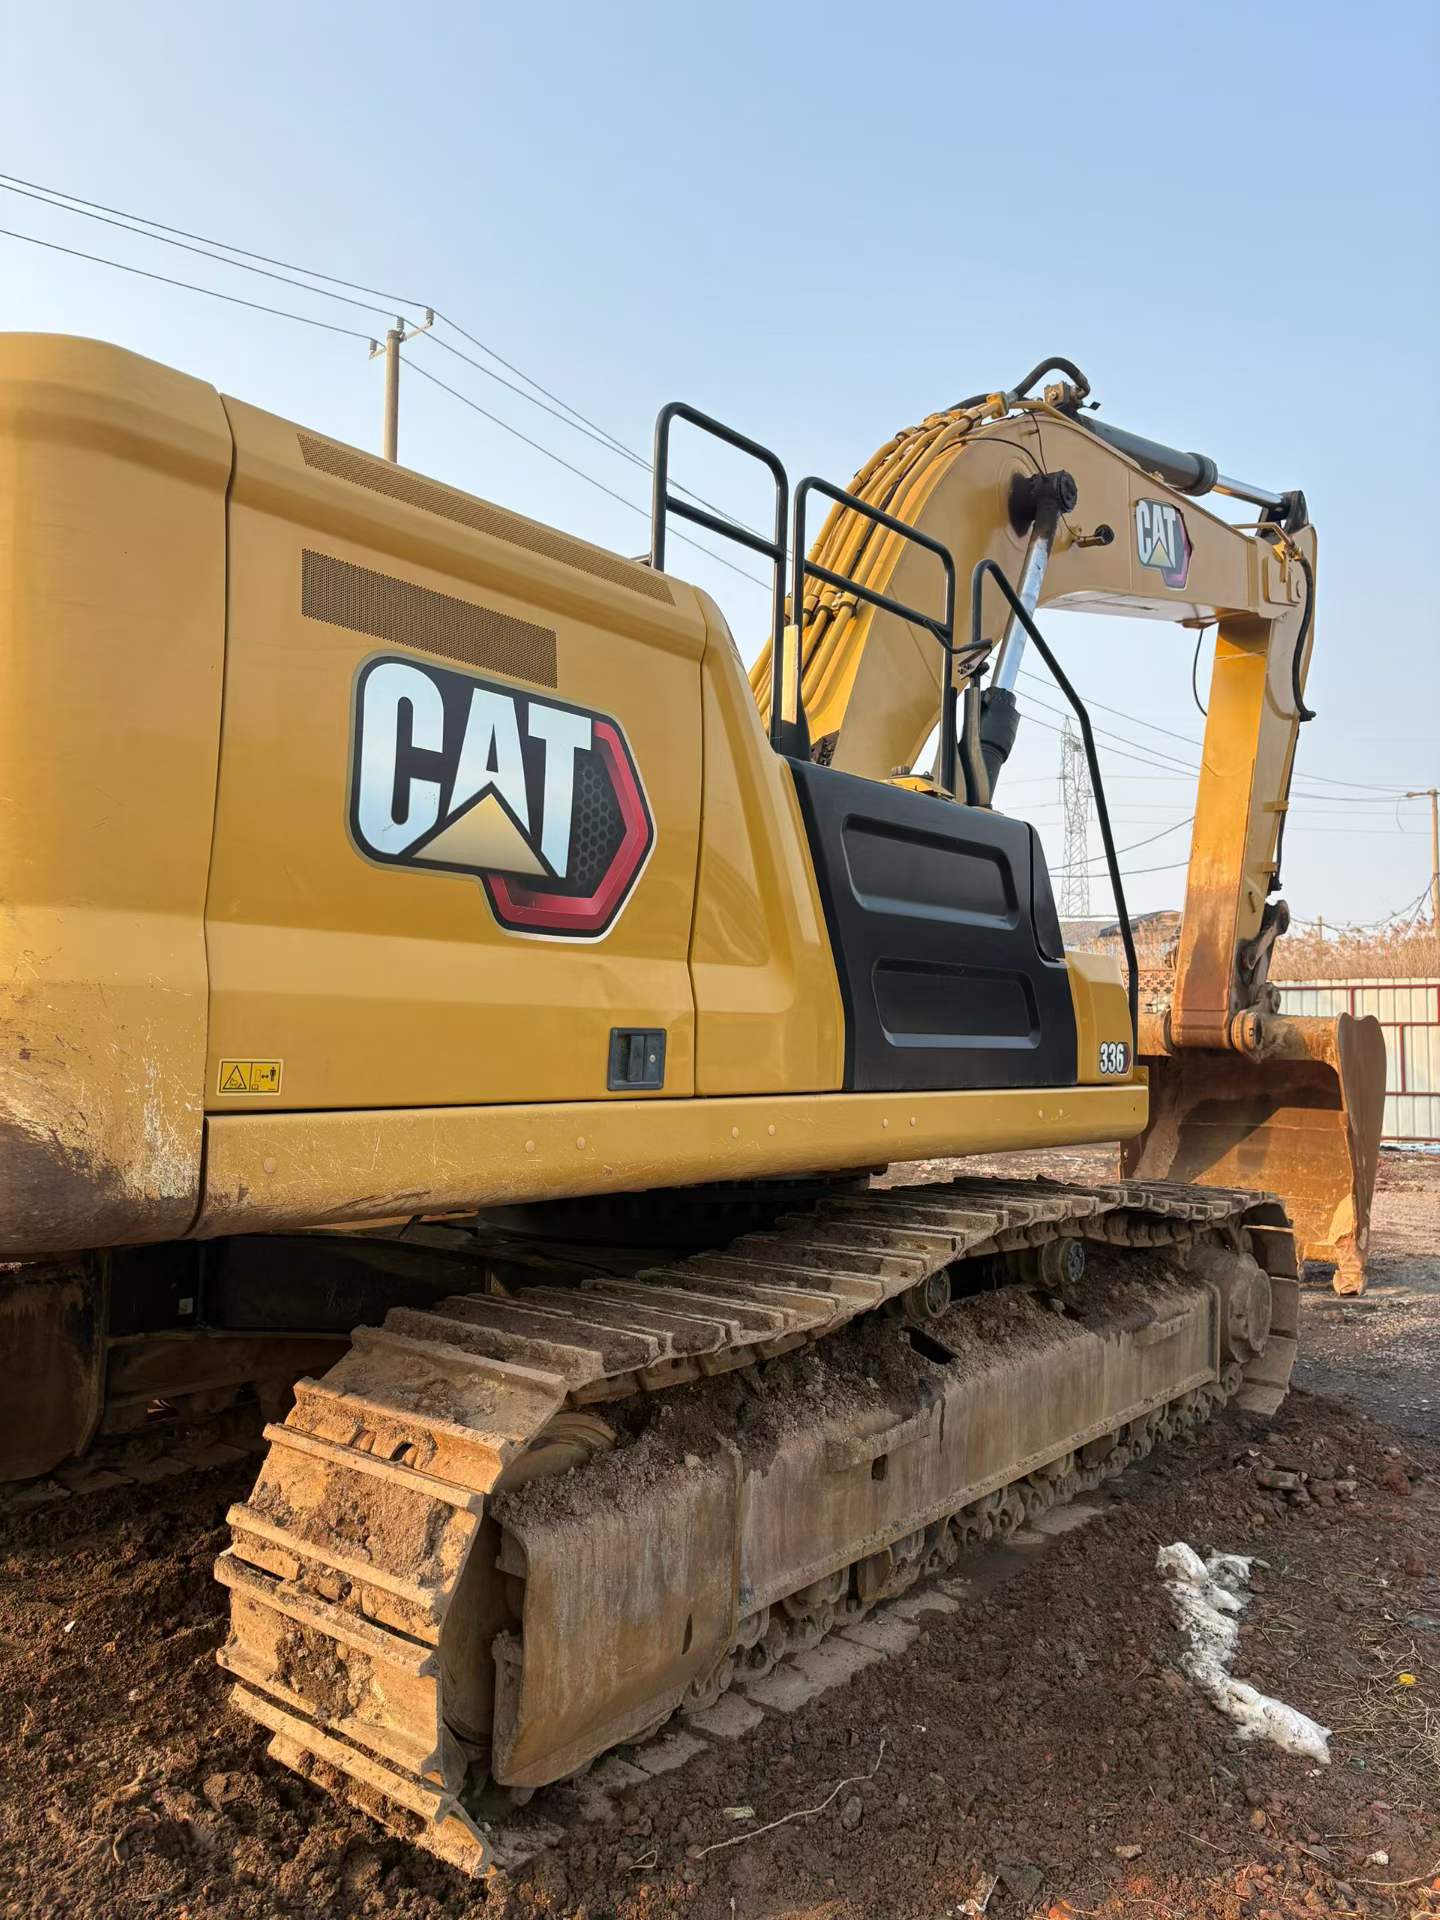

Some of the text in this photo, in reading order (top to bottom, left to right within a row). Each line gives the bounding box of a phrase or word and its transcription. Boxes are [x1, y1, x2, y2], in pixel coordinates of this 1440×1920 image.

[1136, 499, 1176, 569] CAT
[358, 662, 592, 879] CAT
[1100, 1042, 1124, 1073] 336
